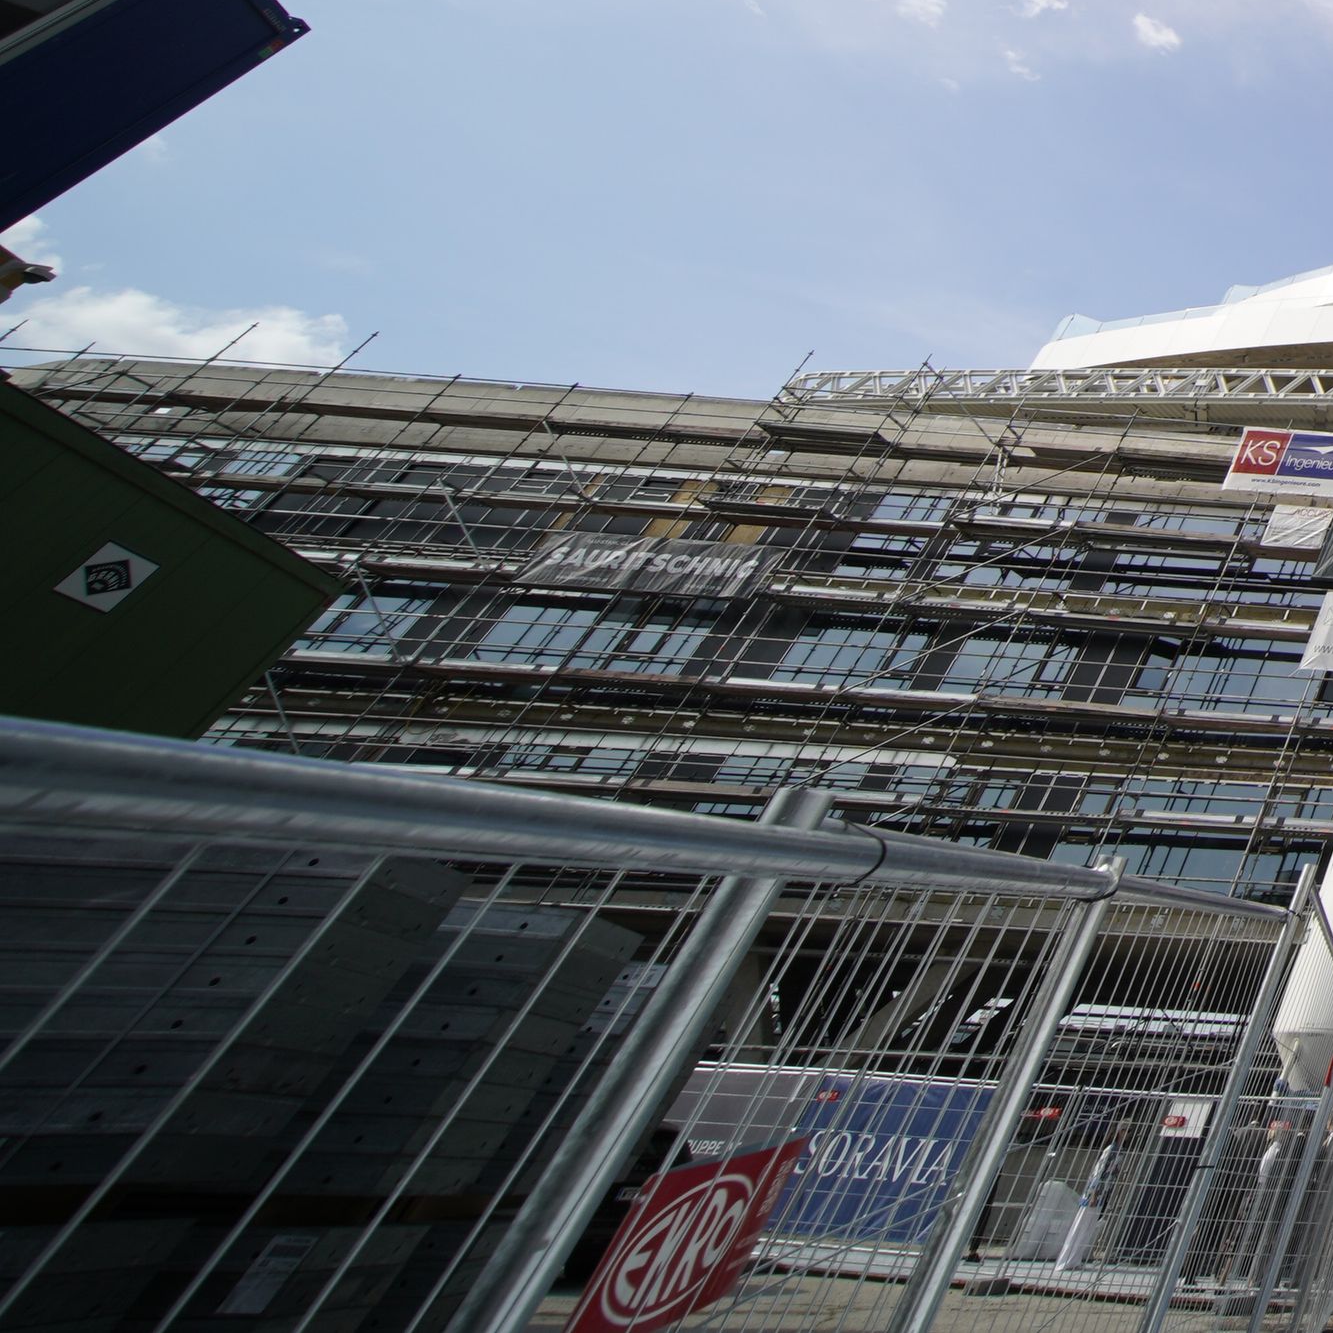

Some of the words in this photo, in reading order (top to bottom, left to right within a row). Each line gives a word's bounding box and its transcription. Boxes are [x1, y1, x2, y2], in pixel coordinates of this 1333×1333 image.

[1240, 440, 1281, 466] KS
[545, 546, 759, 579] SAURITSCHNIG
[793, 1129, 952, 1186] SORAVIA
[614, 1187, 745, 1310] EKRO
